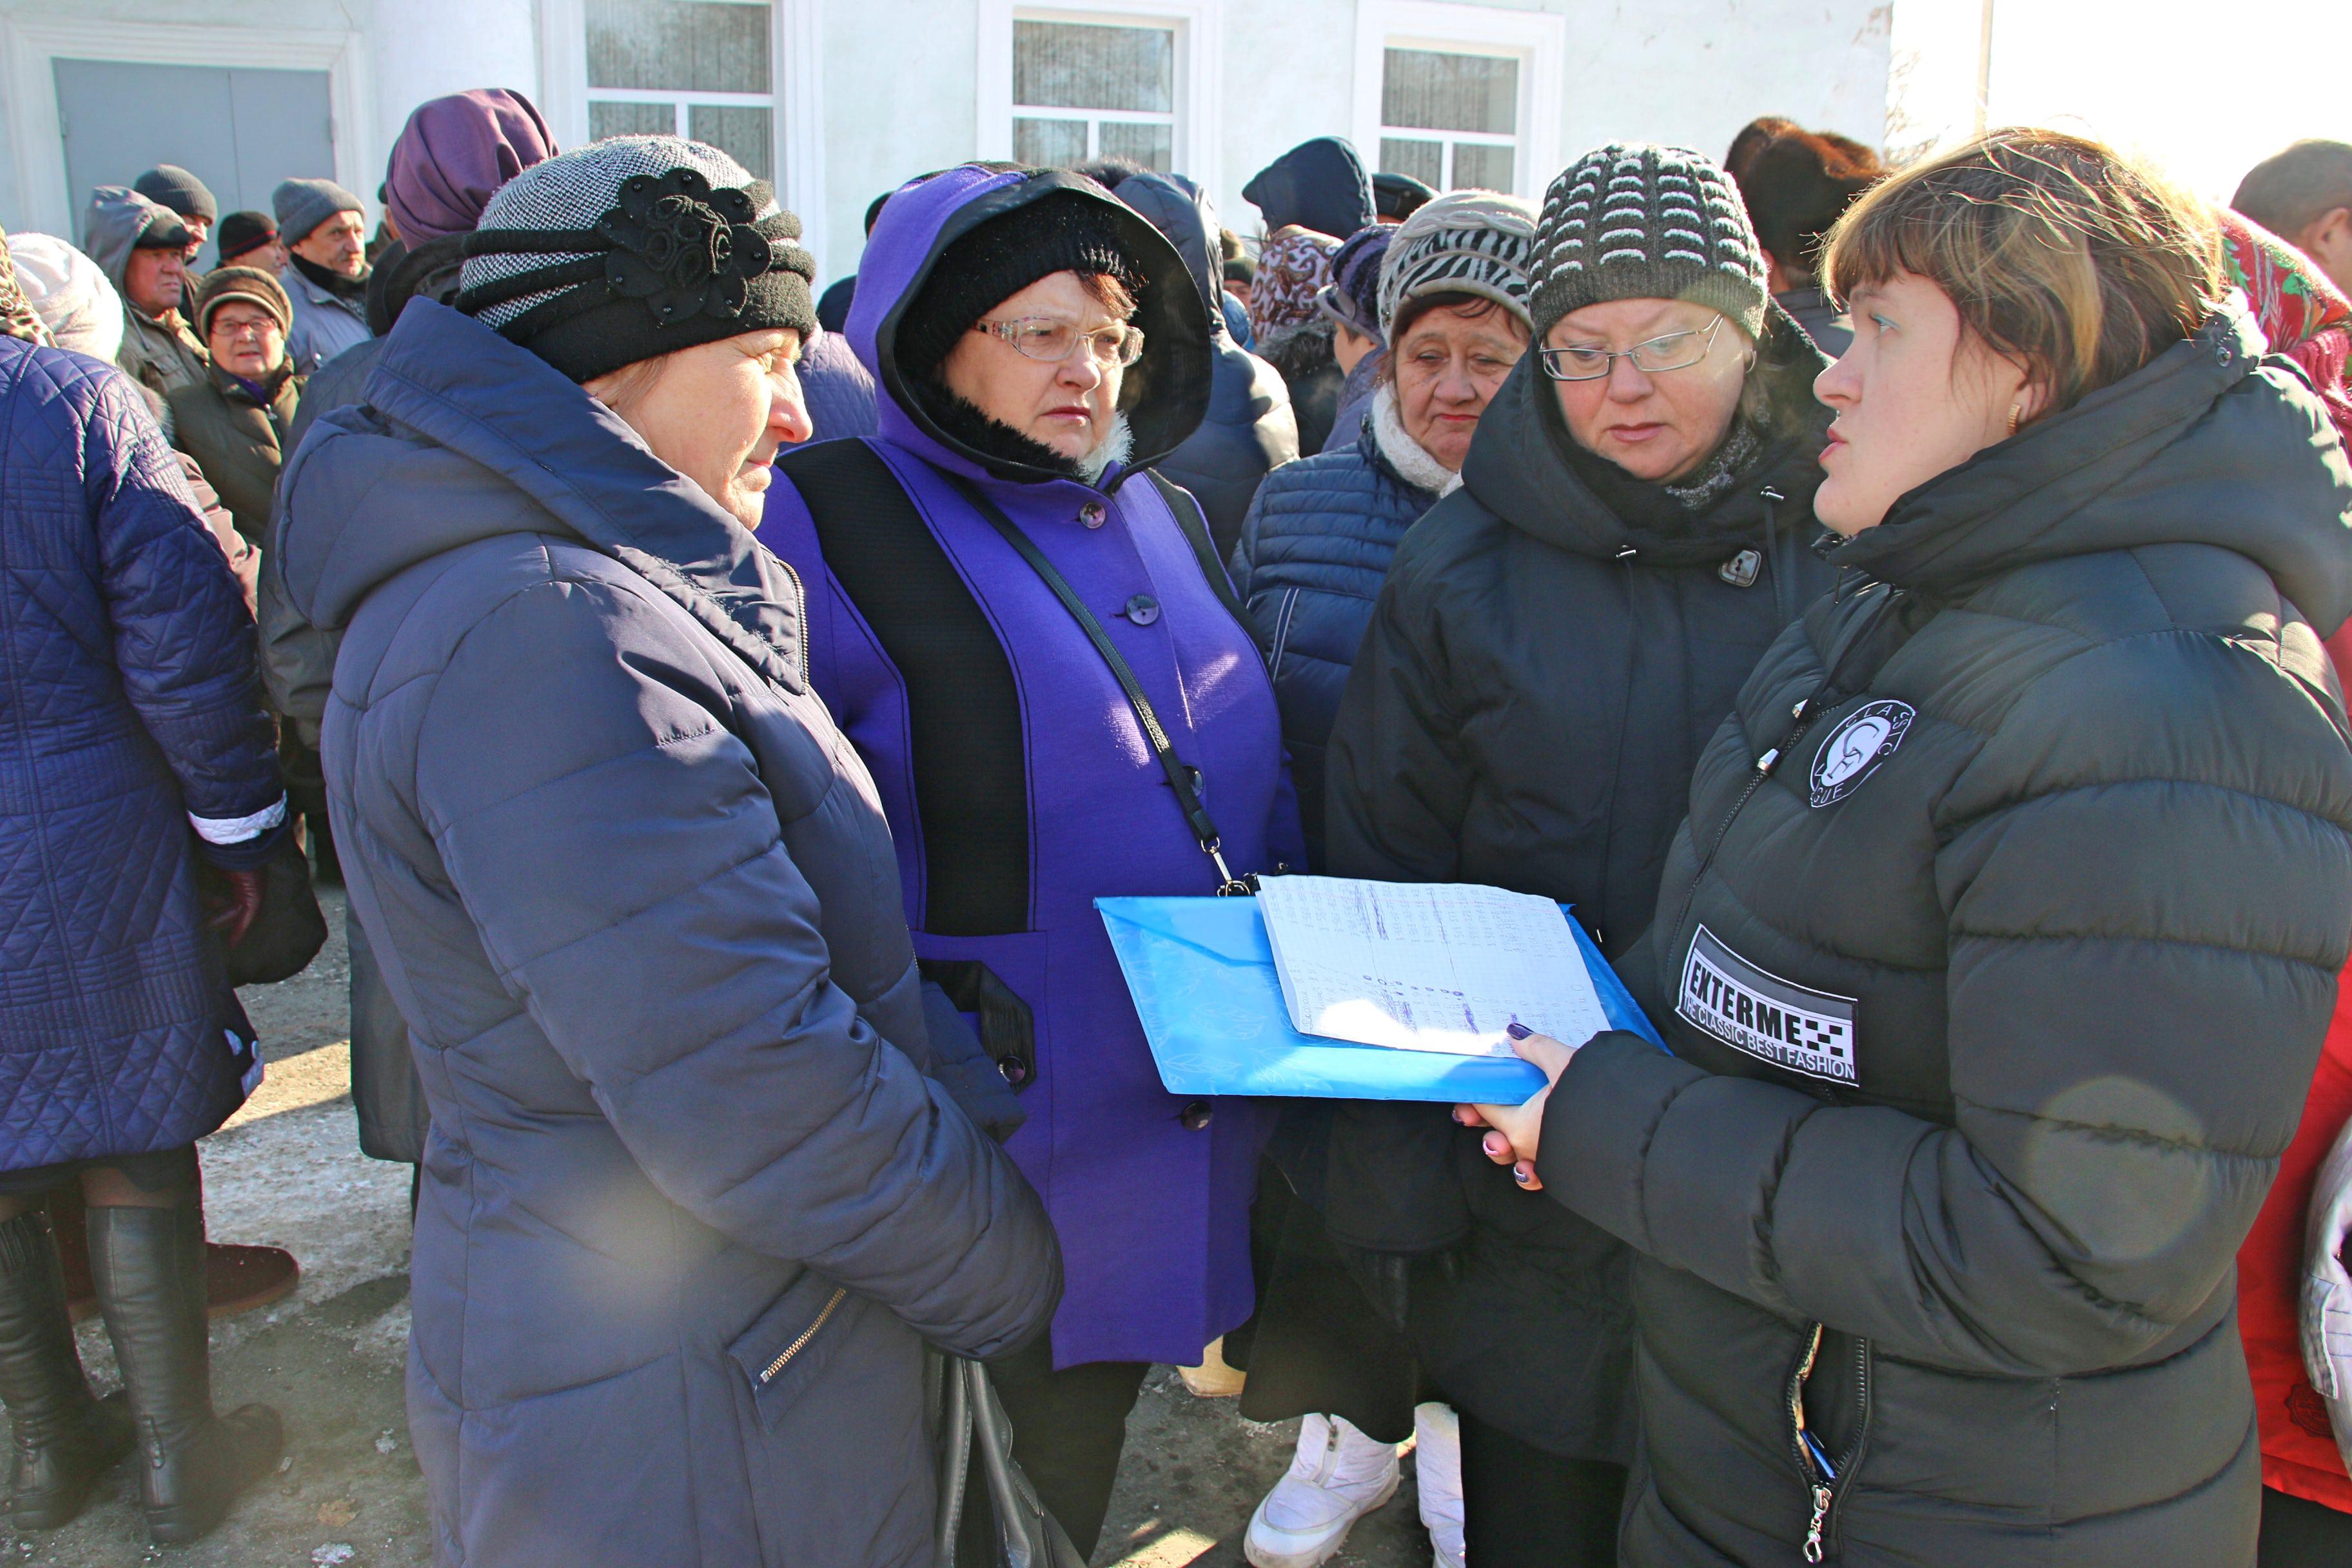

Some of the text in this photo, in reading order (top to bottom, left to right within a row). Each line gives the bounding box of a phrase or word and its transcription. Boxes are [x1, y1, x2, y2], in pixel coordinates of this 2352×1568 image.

[1690, 960, 1803, 1047] EXTERME
[1698, 1006, 1744, 1045] CLASSIC
[1747, 1034, 1783, 1061] BEST
[1787, 1050, 1855, 1080] FASHION
